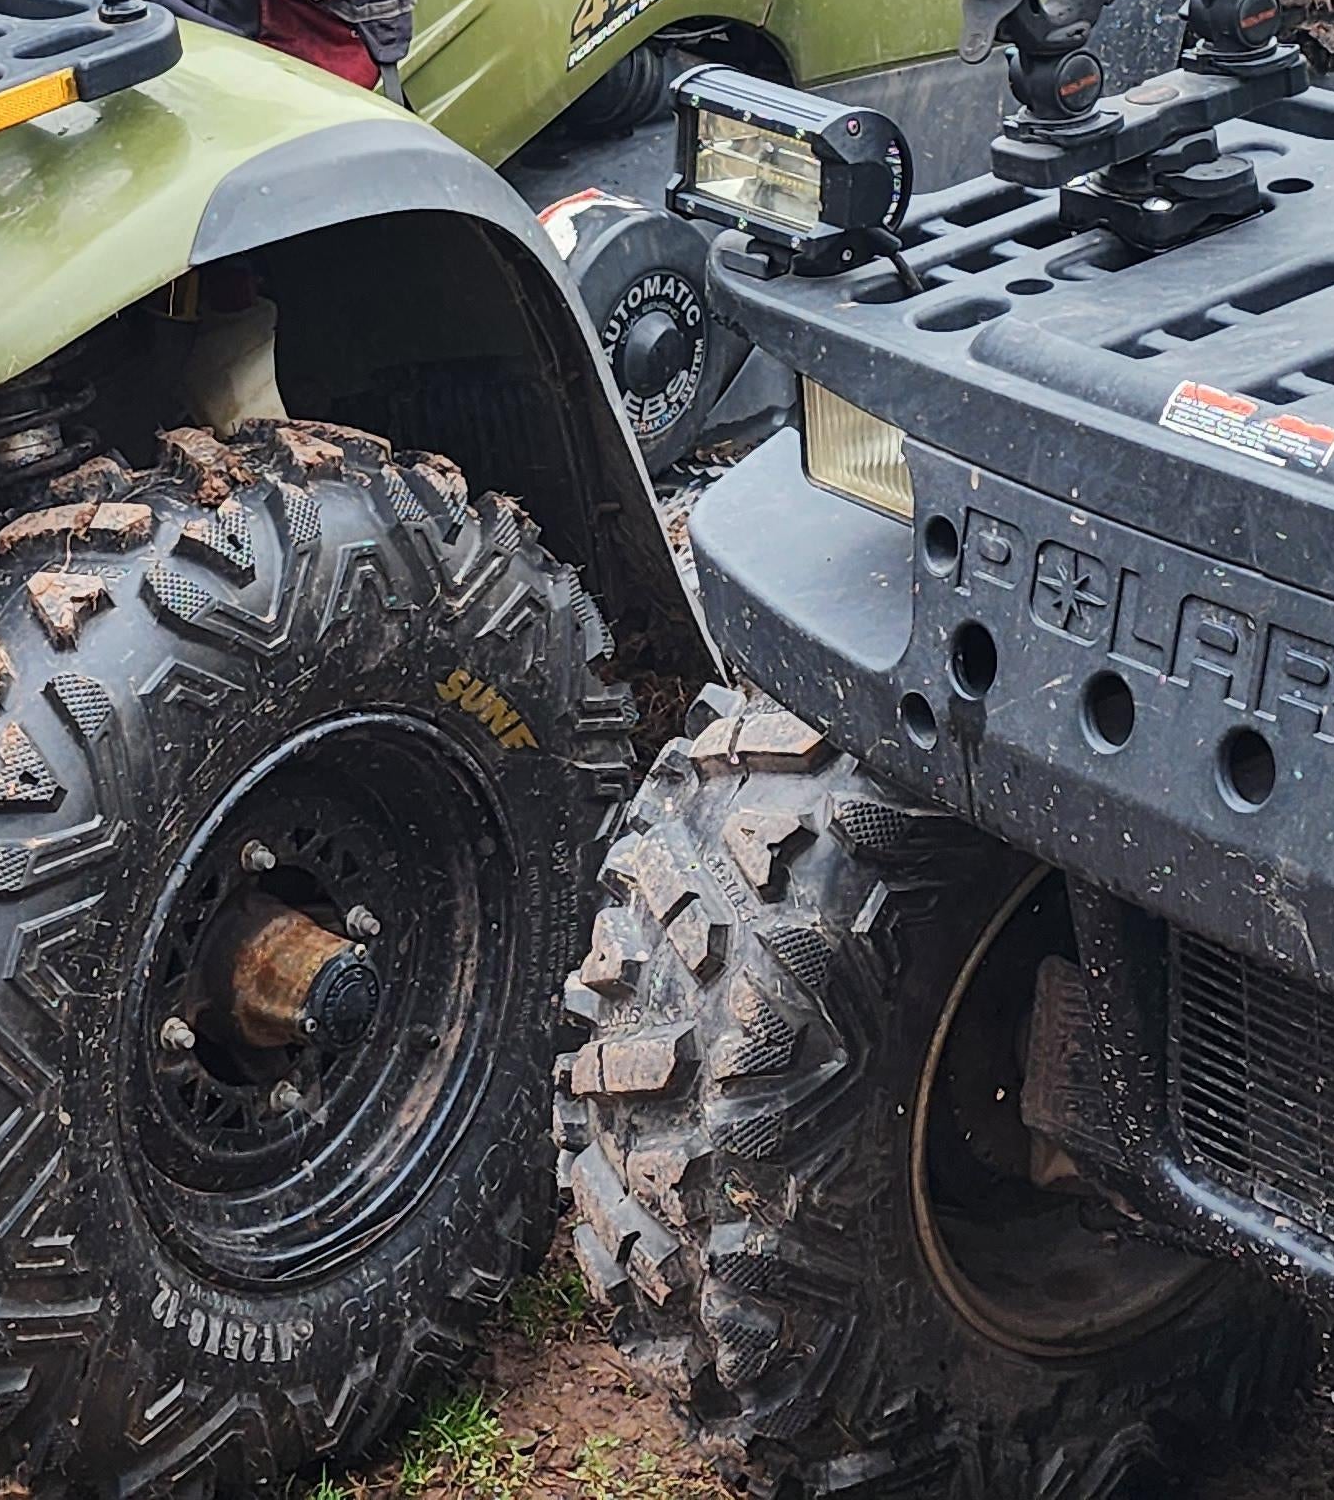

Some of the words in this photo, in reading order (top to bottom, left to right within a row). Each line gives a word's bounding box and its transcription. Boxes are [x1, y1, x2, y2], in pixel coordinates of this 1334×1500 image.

[603, 275, 702, 365] AUTOMATIC
[623, 369, 689, 422] EBS
[679, 337, 705, 403] SYSTEM
